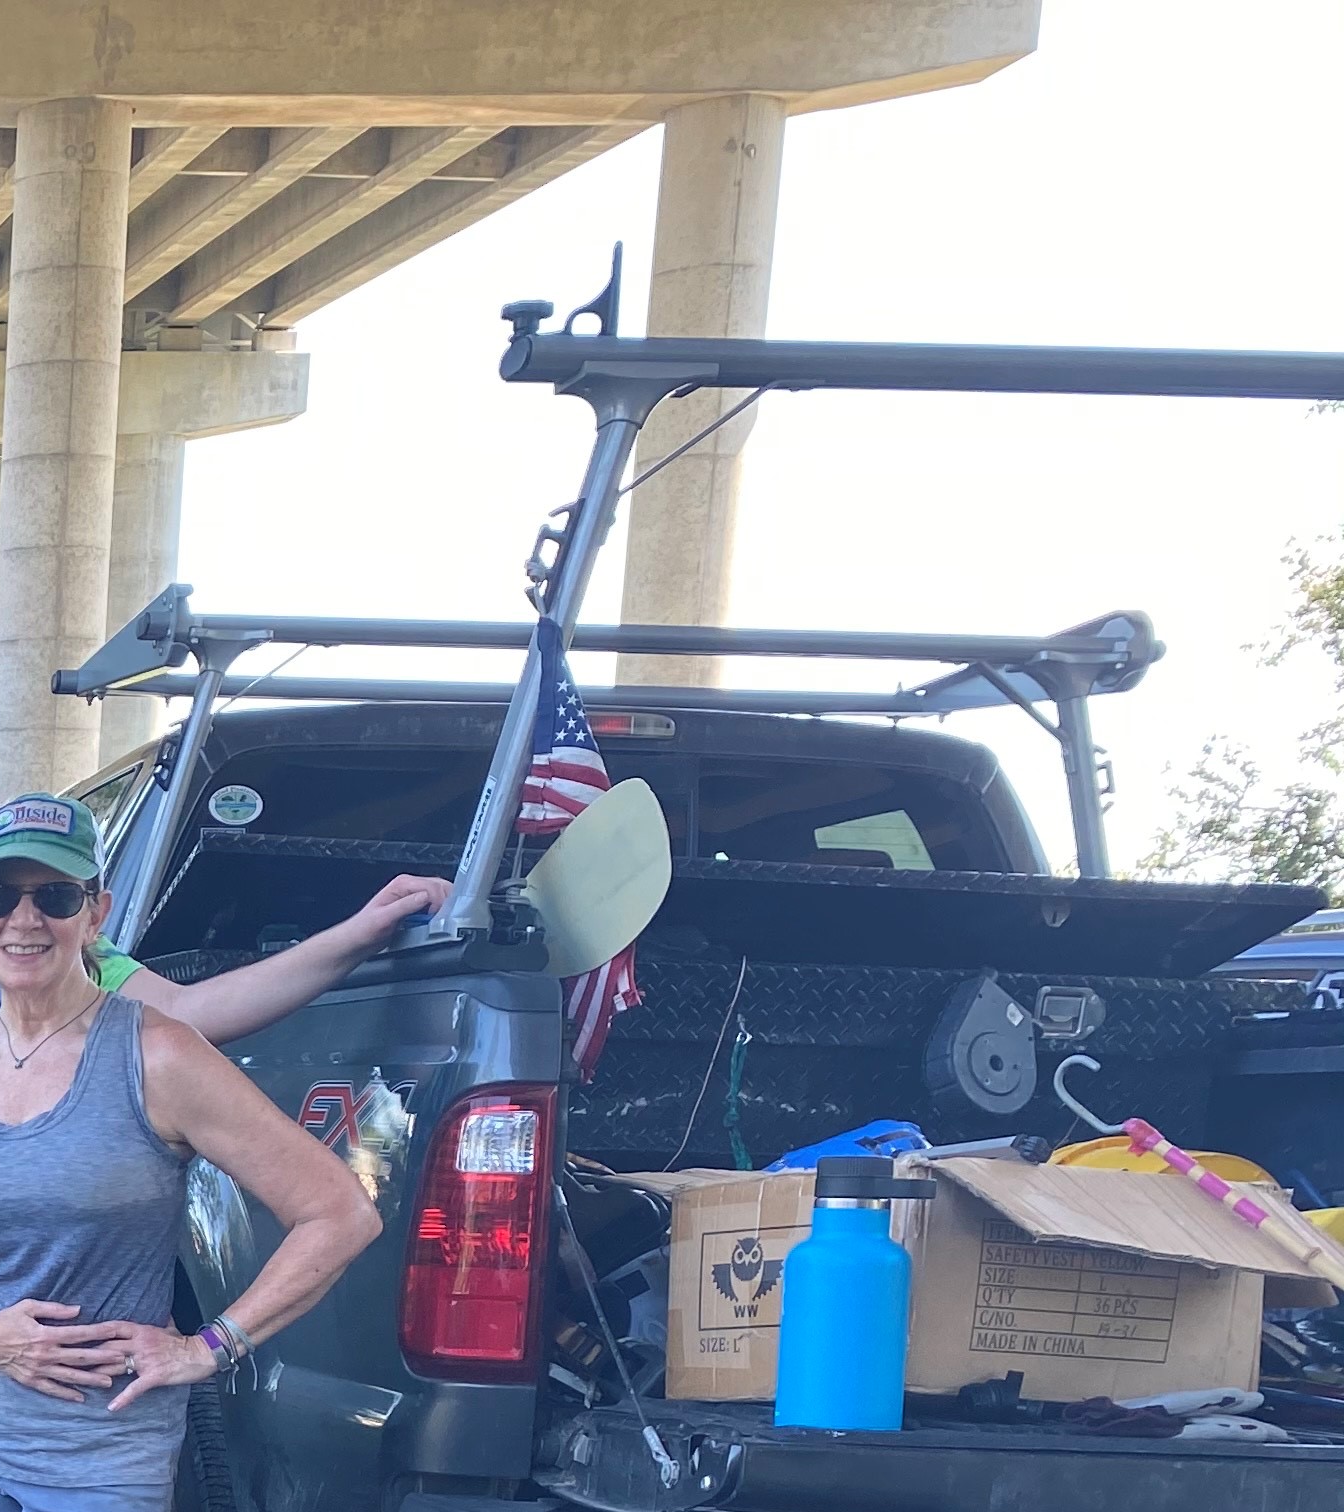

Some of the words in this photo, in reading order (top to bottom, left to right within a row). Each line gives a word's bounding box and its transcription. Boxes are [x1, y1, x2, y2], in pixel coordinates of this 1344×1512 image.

[985, 1246, 1042, 1265] SAFETY
[1043, 1251, 1076, 1268] VEST
[1090, 1253, 1147, 1273] YELLOW
[984, 1267, 1015, 1285] SIZE
[1099, 1276, 1108, 1292] L
[733, 1304, 759, 1319] WW
[1093, 1299, 1110, 1313] 36
[1113, 1300, 1139, 1316] PCS
[699, 1337, 730, 1353] SIZE:
[733, 1338, 741, 1353] L
[976, 1332, 1017, 1351] MADE
[1022, 1335, 1038, 1352] IN
[1043, 1336, 1086, 1355] CHINA
